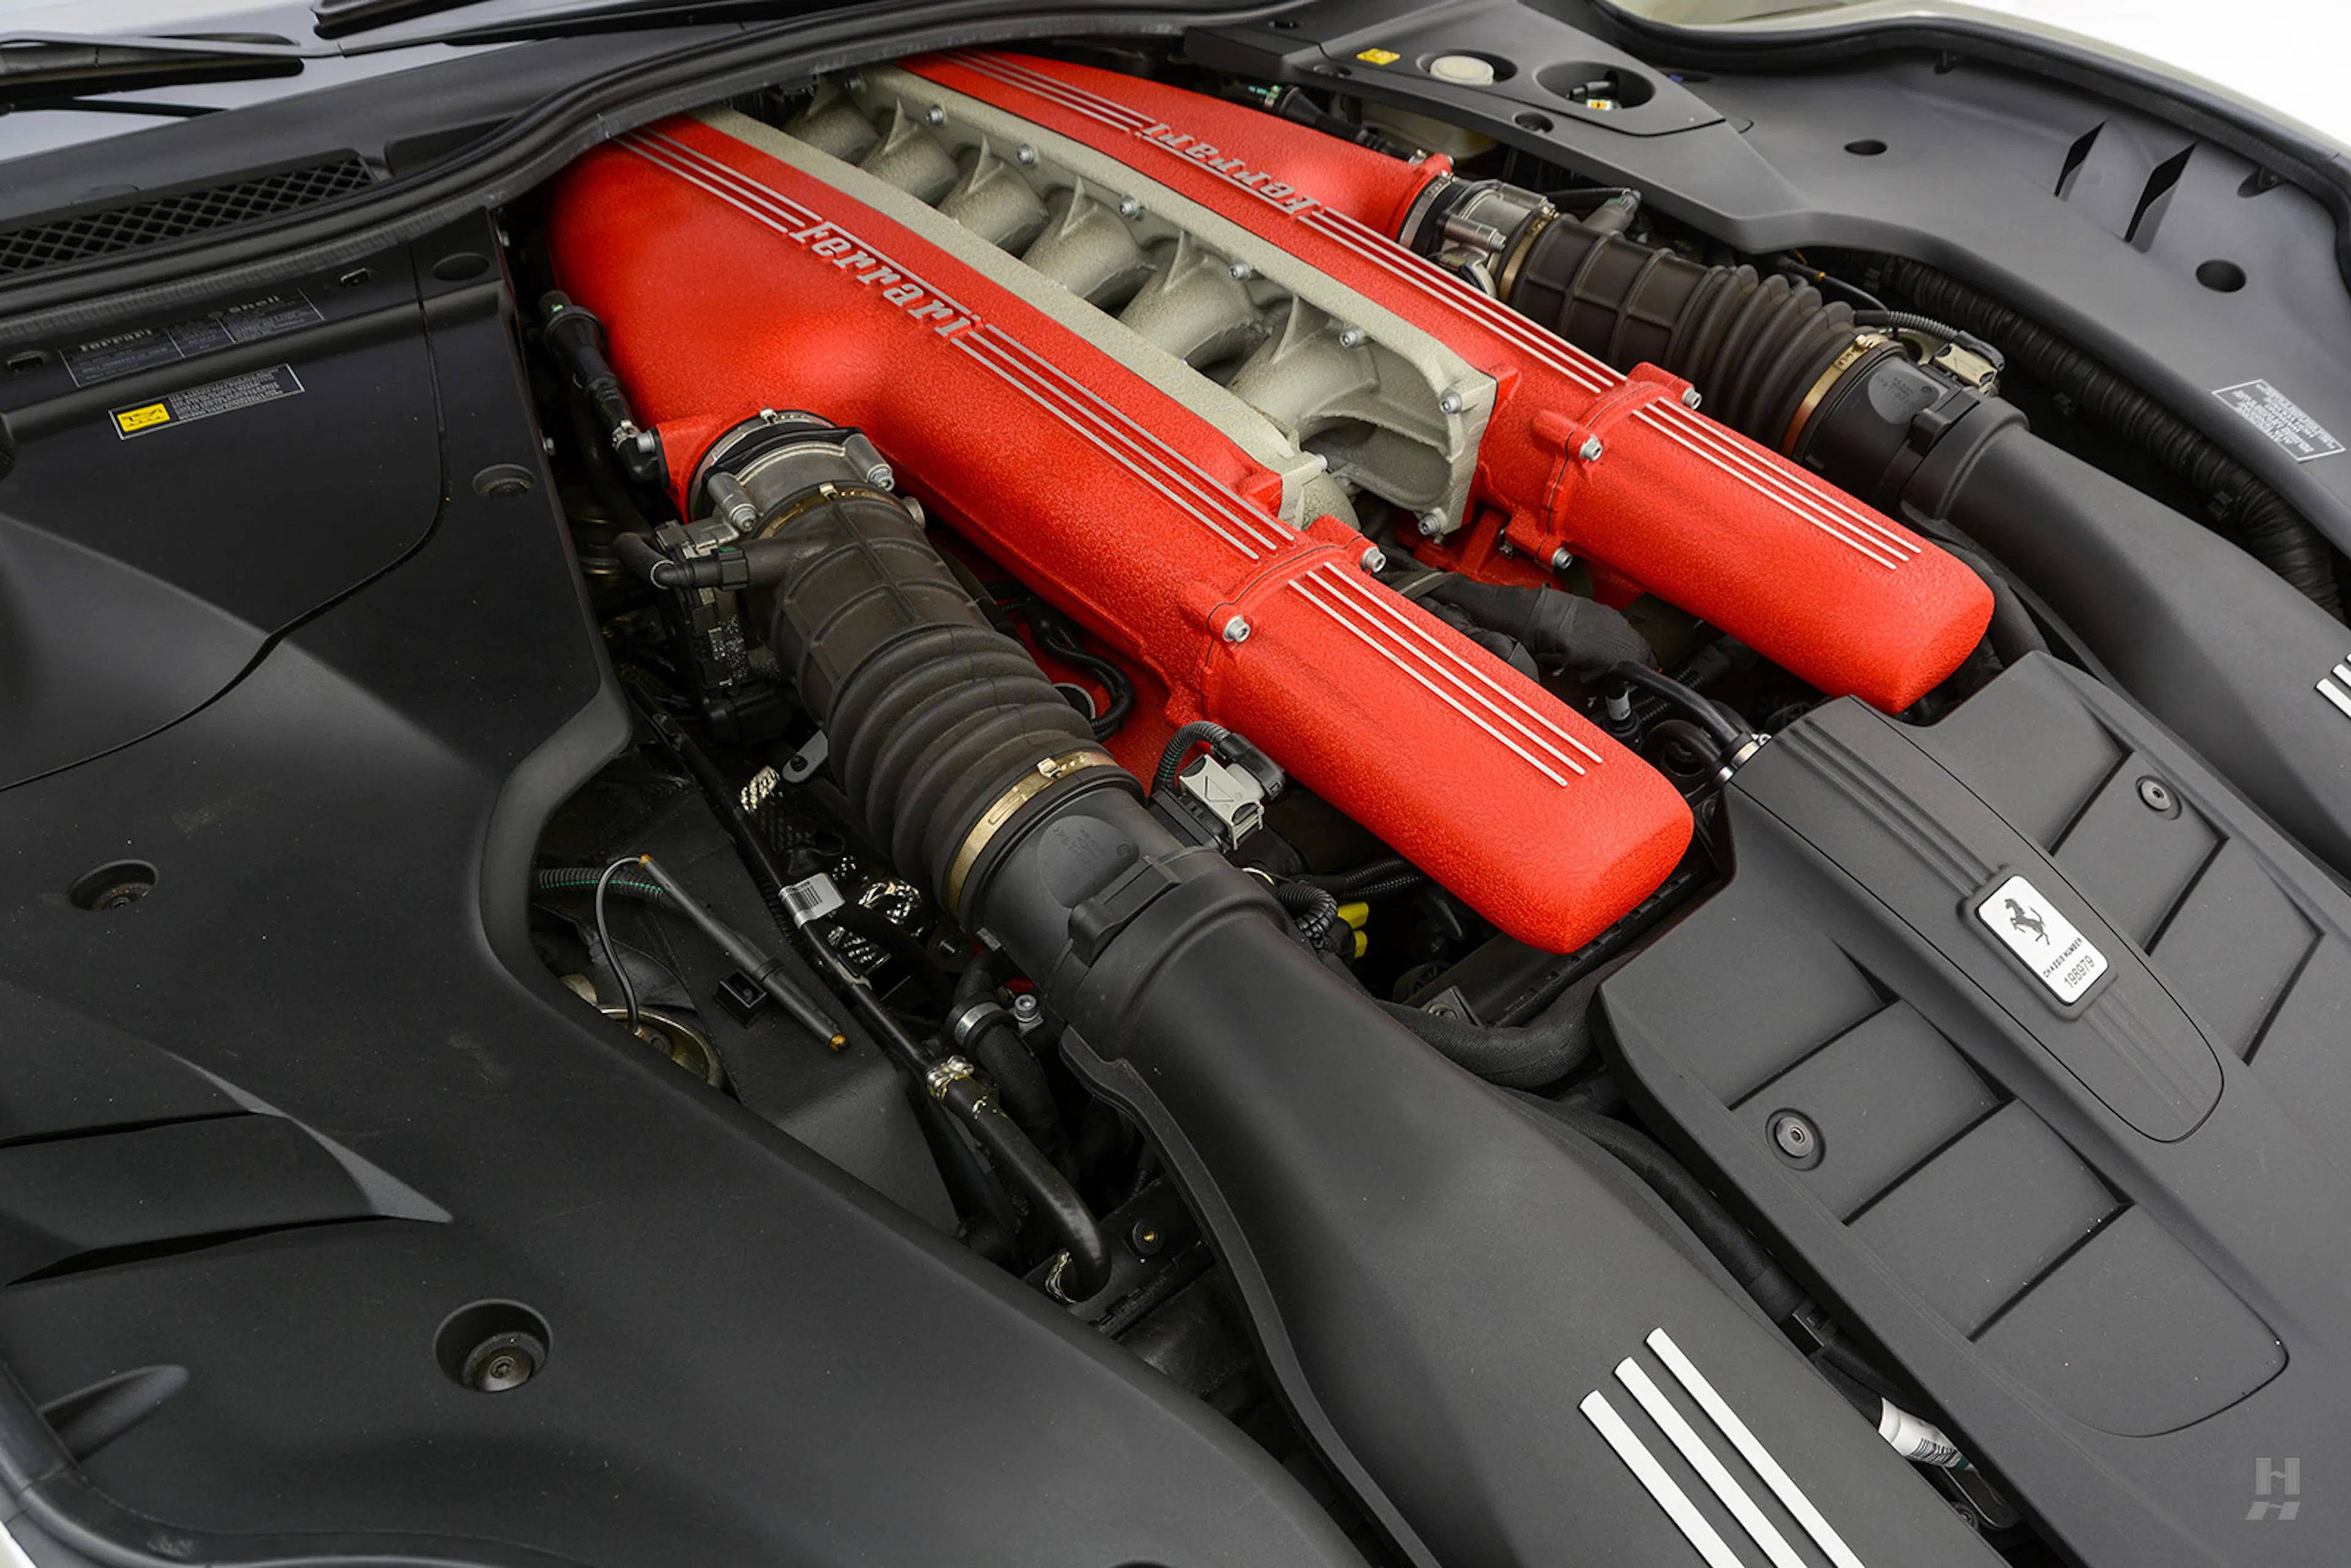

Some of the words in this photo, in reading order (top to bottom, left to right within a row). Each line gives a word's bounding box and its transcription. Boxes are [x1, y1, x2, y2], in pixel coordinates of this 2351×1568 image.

[1134, 122, 1321, 215] Ferrari
[789, 220, 981, 337] Ferrari
[2043, 955, 2065, 978] CHASSIS
[2064, 937, 2083, 957] NUMBER
[2064, 955, 2095, 988] 198979
